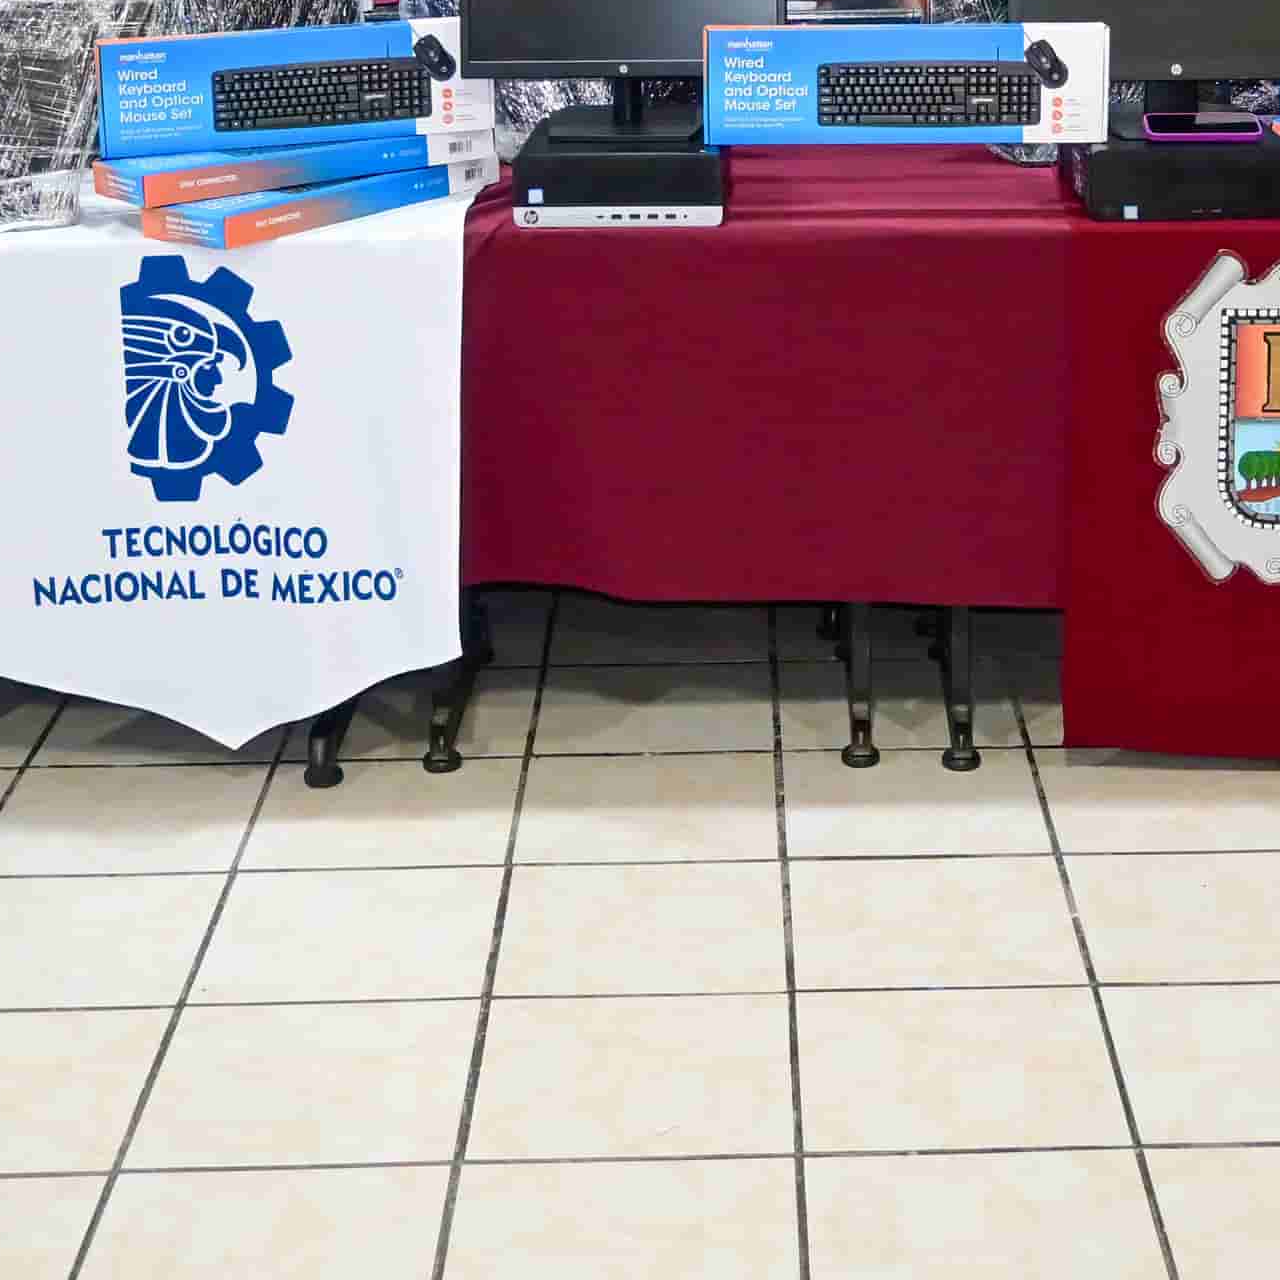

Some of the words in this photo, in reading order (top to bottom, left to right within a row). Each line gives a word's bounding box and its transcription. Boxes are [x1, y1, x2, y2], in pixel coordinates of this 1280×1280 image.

[724, 56, 765, 69] Wired
[116, 68, 158, 81] Wired
[724, 71, 792, 85] Keyboard
[118, 80, 186, 97] Keyboard
[724, 85, 753, 97] and
[756, 84, 809, 100] Optical
[119, 97, 148, 109] and
[151, 94, 205, 110] Optical
[724, 99, 771, 112] Mouse
[775, 98, 797, 112] Set
[119, 110, 167, 124] Mouse
[170, 108, 193, 121] Set
[101, 517, 328, 560] TECNOLÓGICO
[32, 569, 207, 607] NACIONAL
[220, 568, 260, 599] DE
